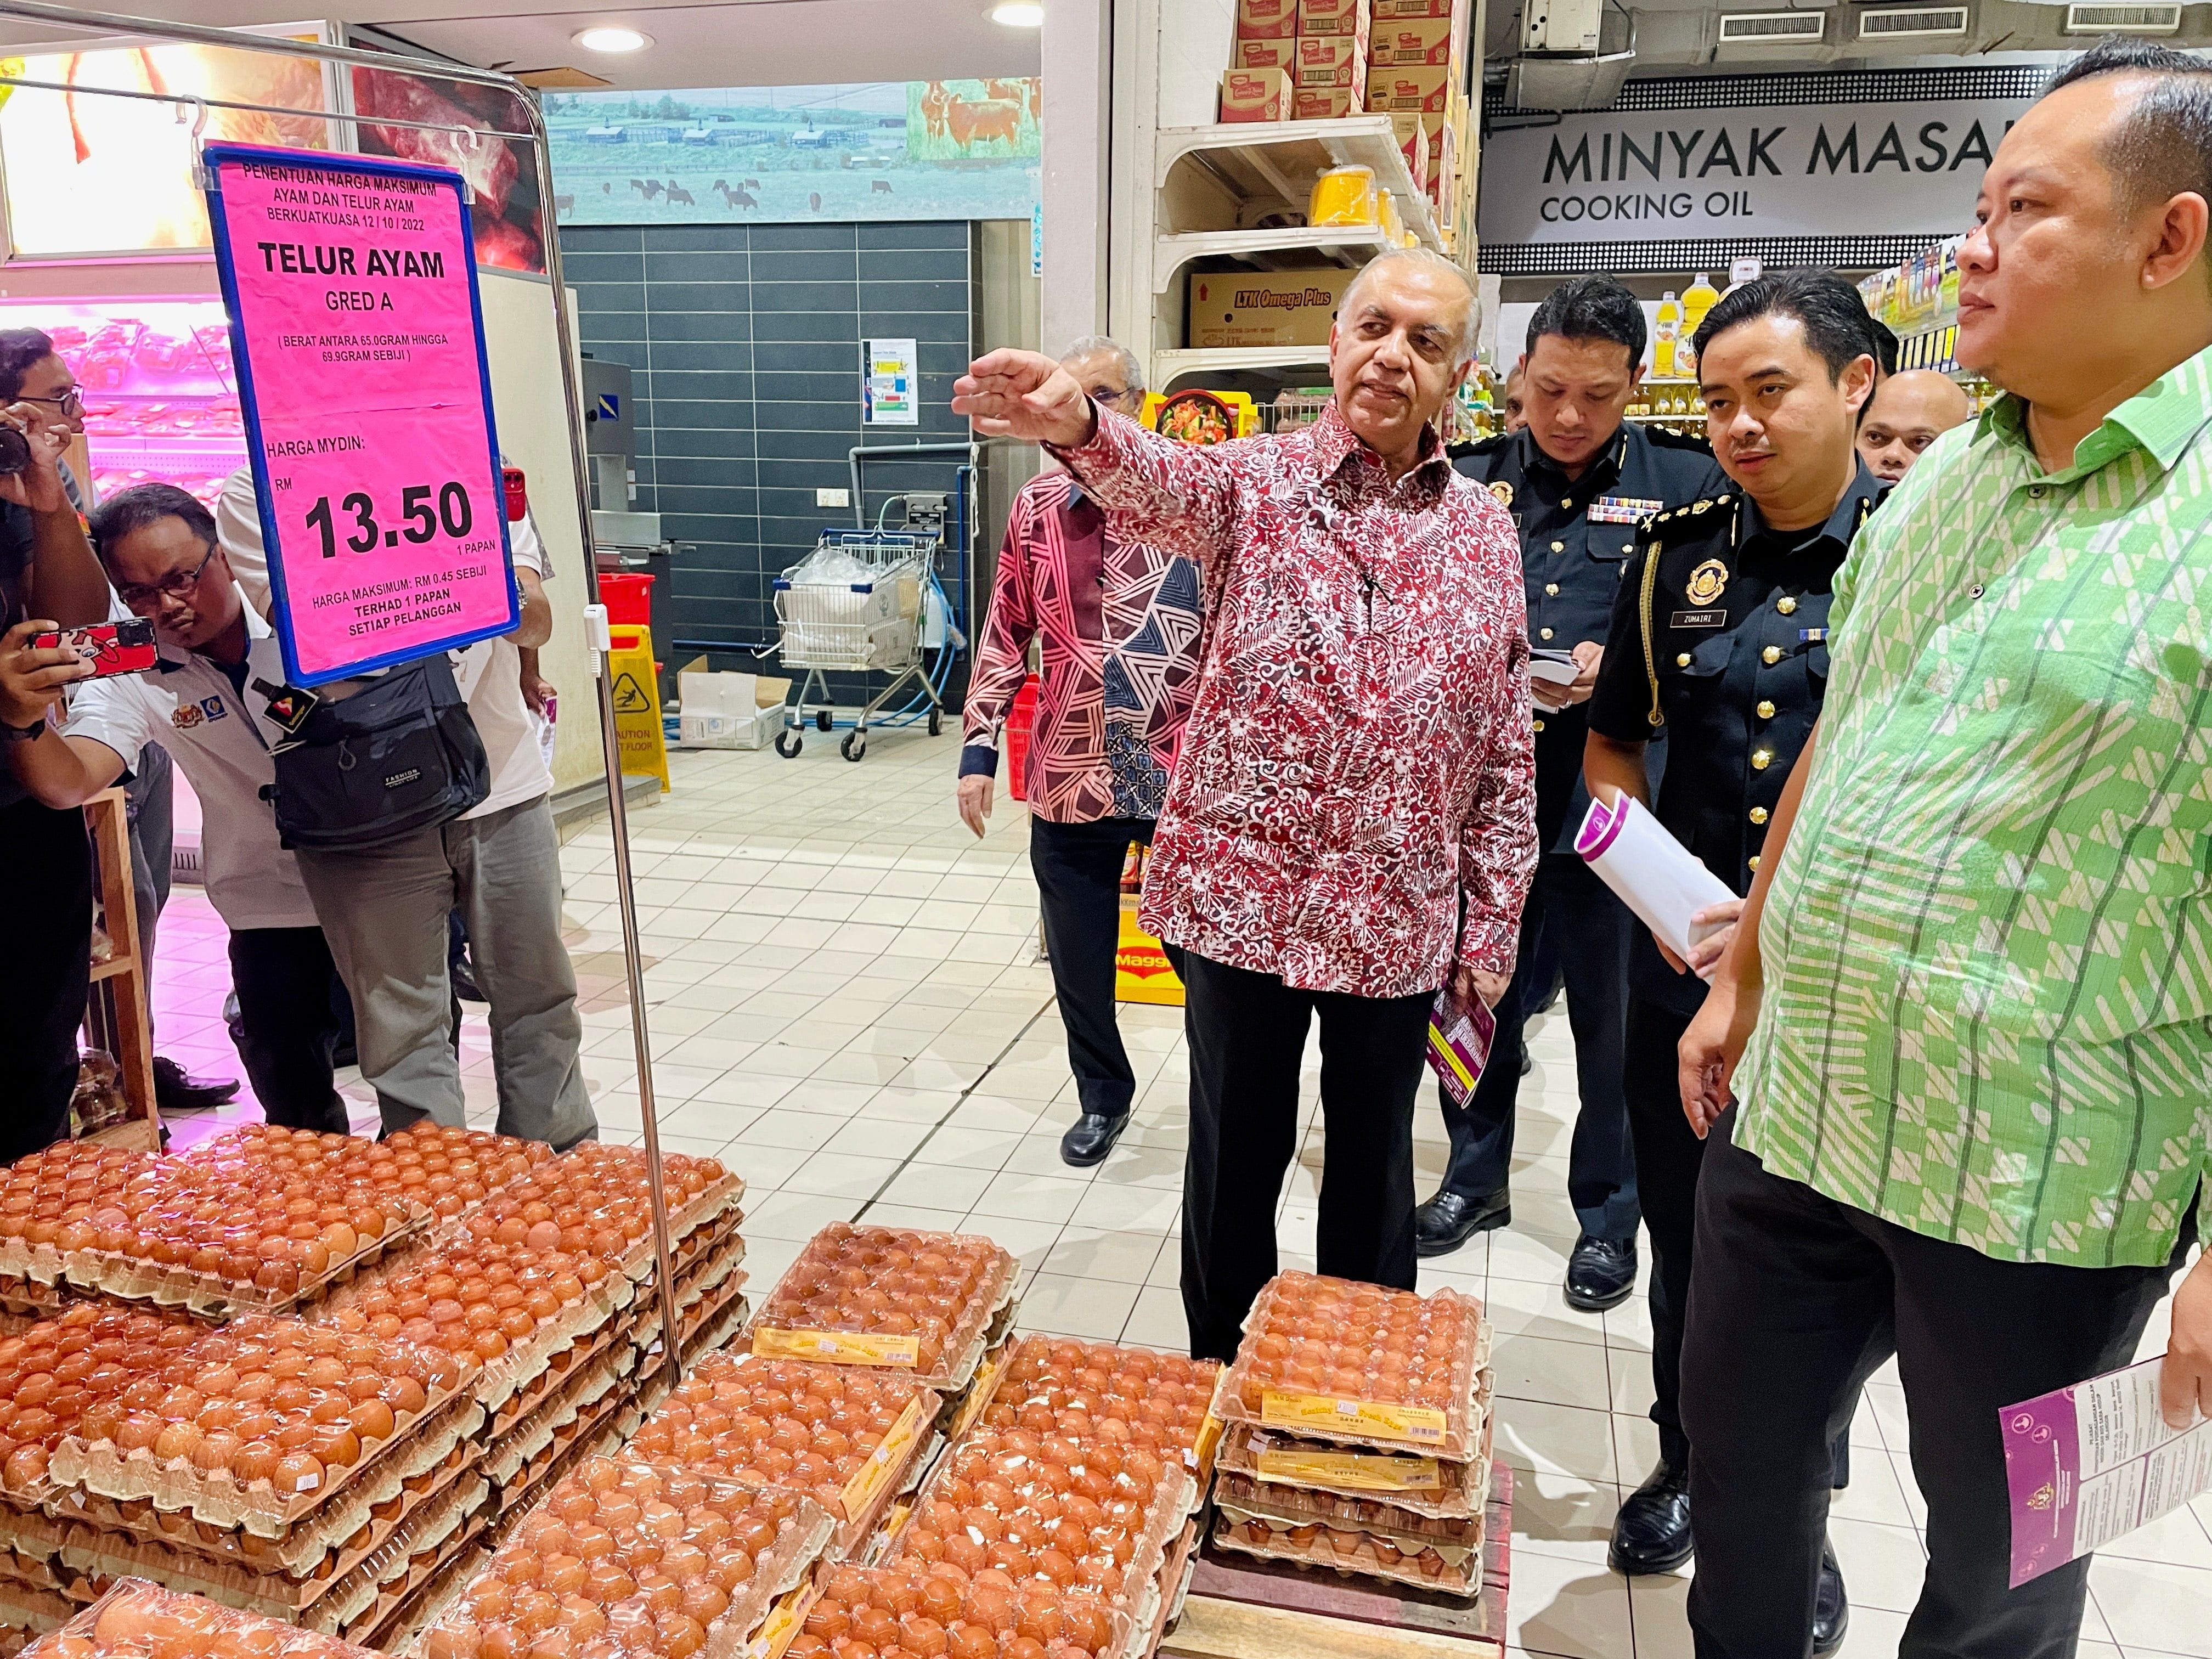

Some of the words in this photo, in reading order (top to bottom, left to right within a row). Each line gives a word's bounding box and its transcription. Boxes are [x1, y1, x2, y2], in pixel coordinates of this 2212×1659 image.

[1542, 126, 1787, 185] MINYAK
[1805, 117, 2015, 175] MASA
[243, 163, 324, 185] PENENTUAN
[329, 172, 371, 190] HARGA
[374, 178, 437, 196] MAKSIMUM
[274, 188, 309, 205] AYAM
[313, 191, 340, 207] DAN
[343, 194, 381, 210] TELUR
[384, 198, 414, 213] AYAM
[1540, 193, 1692, 222] COOKING
[1705, 190, 1754, 217] OIL
[268, 207, 360, 227] BERKUATKUASA
[363, 215, 374, 227] 12
[382, 217, 393, 228] 10
[402, 218, 425, 231] 2022
[257, 242, 357, 275] TELUR
[366, 249, 444, 278] AYAM
[325, 291, 375, 311] GRED
[381, 292, 394, 311] A
[1234, 290, 1260, 308] LTK
[1260, 289, 1302, 310] Omega
[1304, 288, 1331, 306] Plus
[284, 336, 317, 347] BERAT
[319, 336, 359, 346] ANTARA
[360, 335, 410, 346] 65.0GRAM
[412, 335, 448, 345] HINGGA
[322, 351, 371, 362] 69.9GRAM
[373, 350, 405, 360] SEBIJI
[267, 439, 315, 458] HARGA
[318, 436, 365, 453] MYDIN:
[275, 478, 292, 490] RM
[306, 482, 472, 558] 13.50
[457, 545, 462, 555] 1
[465, 540, 495, 554] PAPAN
[313, 591, 350, 609] HARGA
[352, 580, 412, 601] MAKSIMUM:
[415, 575, 431, 588] RM
[433, 571, 453, 584] 0.45
[456, 566, 486, 580] SEBIJI
[354, 599, 402, 618] TERHAD
[405, 596, 411, 607] 1
[415, 588, 450, 606] PAPAN
[349, 617, 391, 636] SETIAP
[394, 602, 461, 627] PELANGGAN
[617, 730, 650, 739] AUTION
